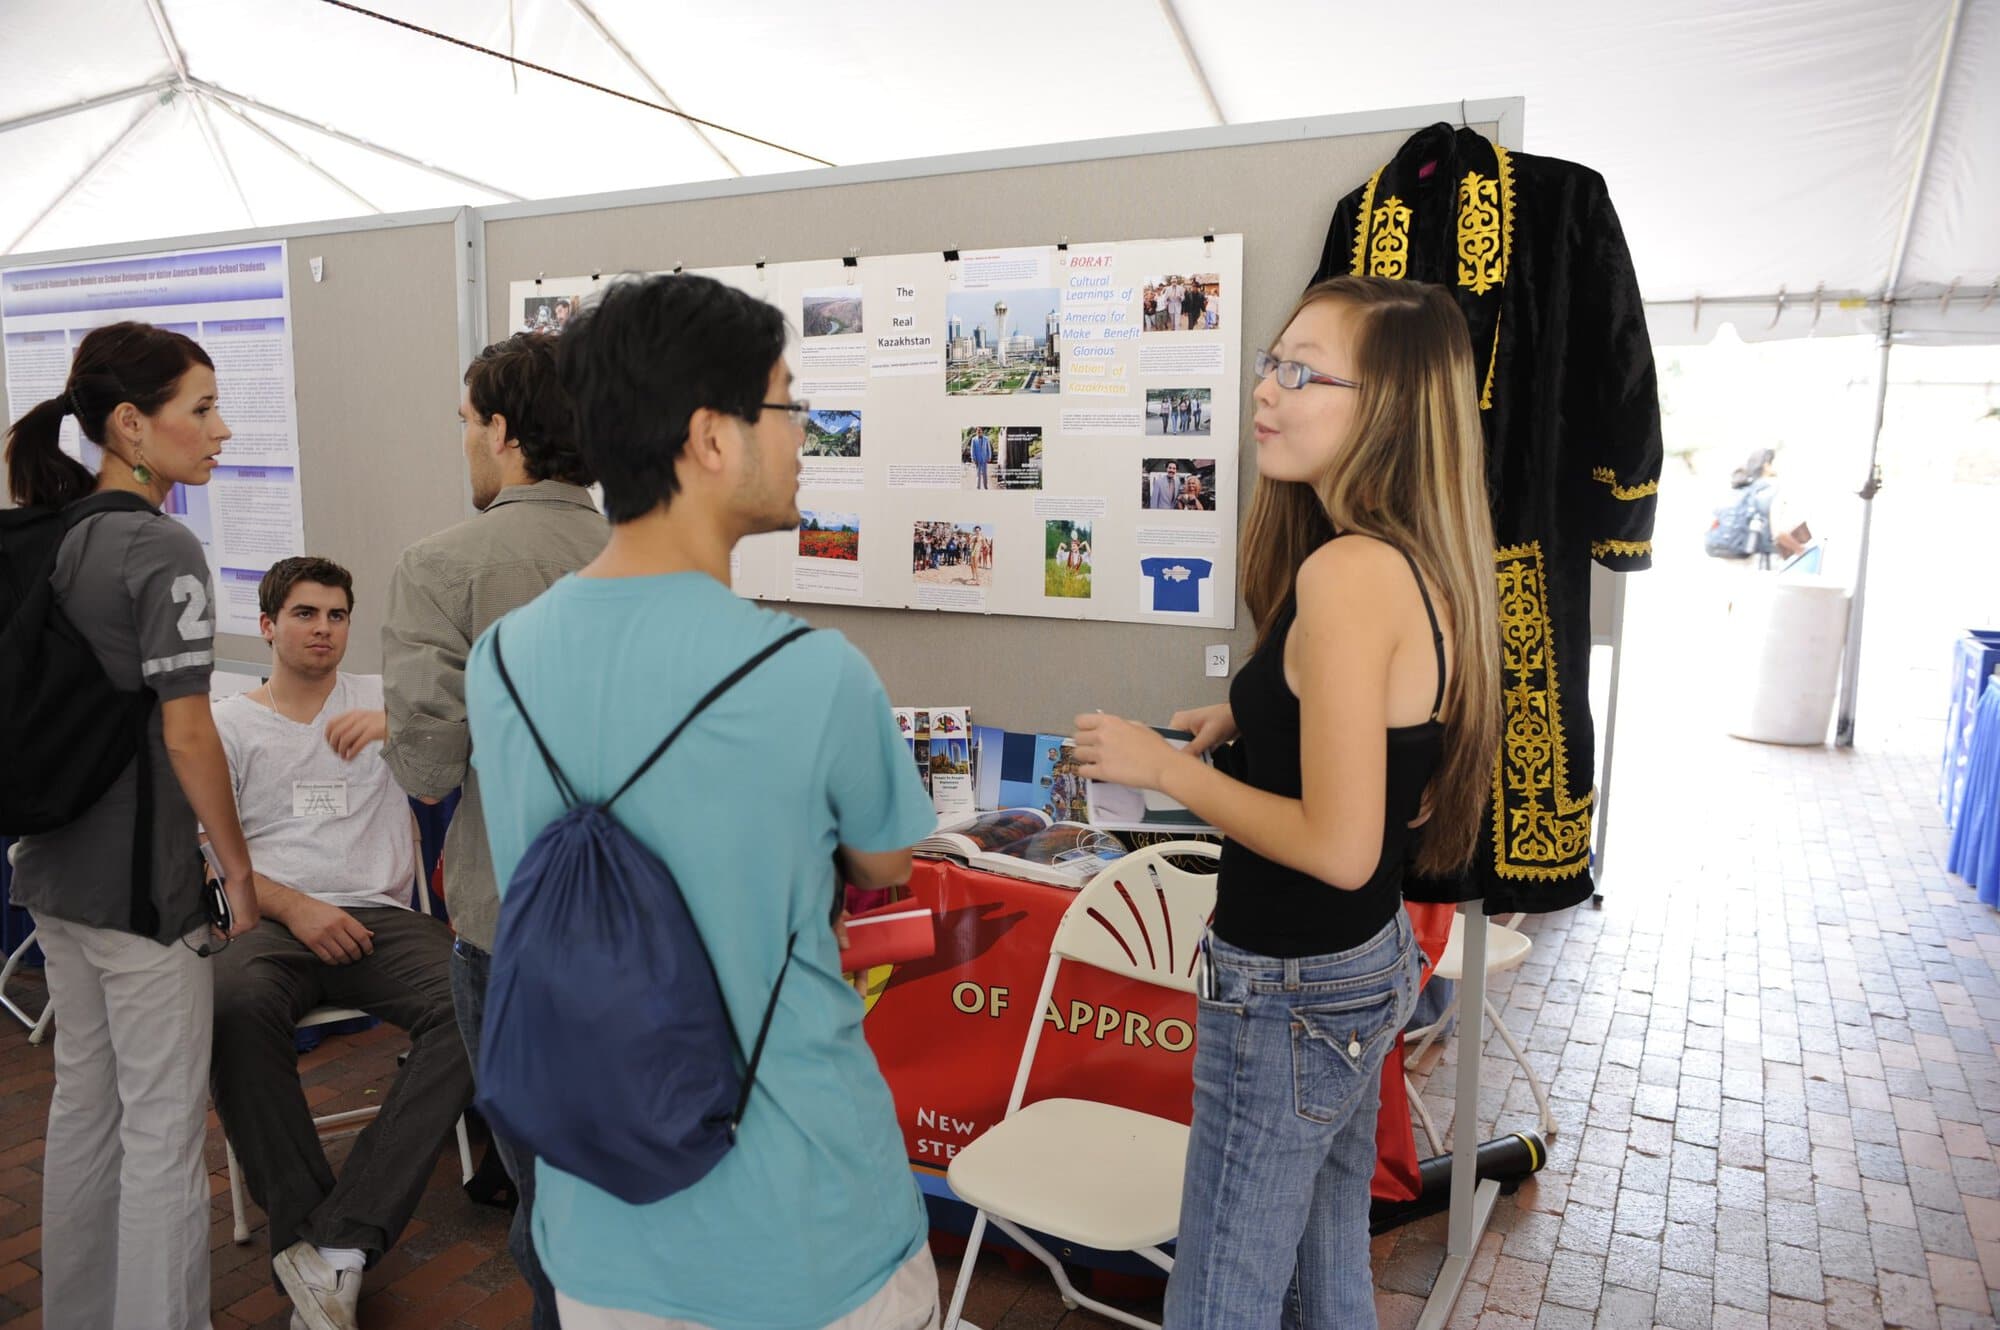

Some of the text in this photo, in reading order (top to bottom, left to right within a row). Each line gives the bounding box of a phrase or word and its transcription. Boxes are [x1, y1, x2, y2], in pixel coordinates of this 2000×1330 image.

[1070, 275, 1110, 288] Cultural
[896, 287, 914, 297] The
[1066, 288, 1133, 302] Learnings of
[893, 317, 913, 327] Real
[1065, 310, 1126, 323] America for
[1062, 327, 1140, 339] Make Benefit
[878, 336, 931, 348] Kazakhstan
[1073, 345, 1115, 357] Glorious
[171, 574, 214, 640] 2
[1212, 655, 1226, 666] 28
[951, 981, 1197, 1052] OF APPRO
[917, 1107, 975, 1135] NEW
[917, 1139, 967, 1159] STE
